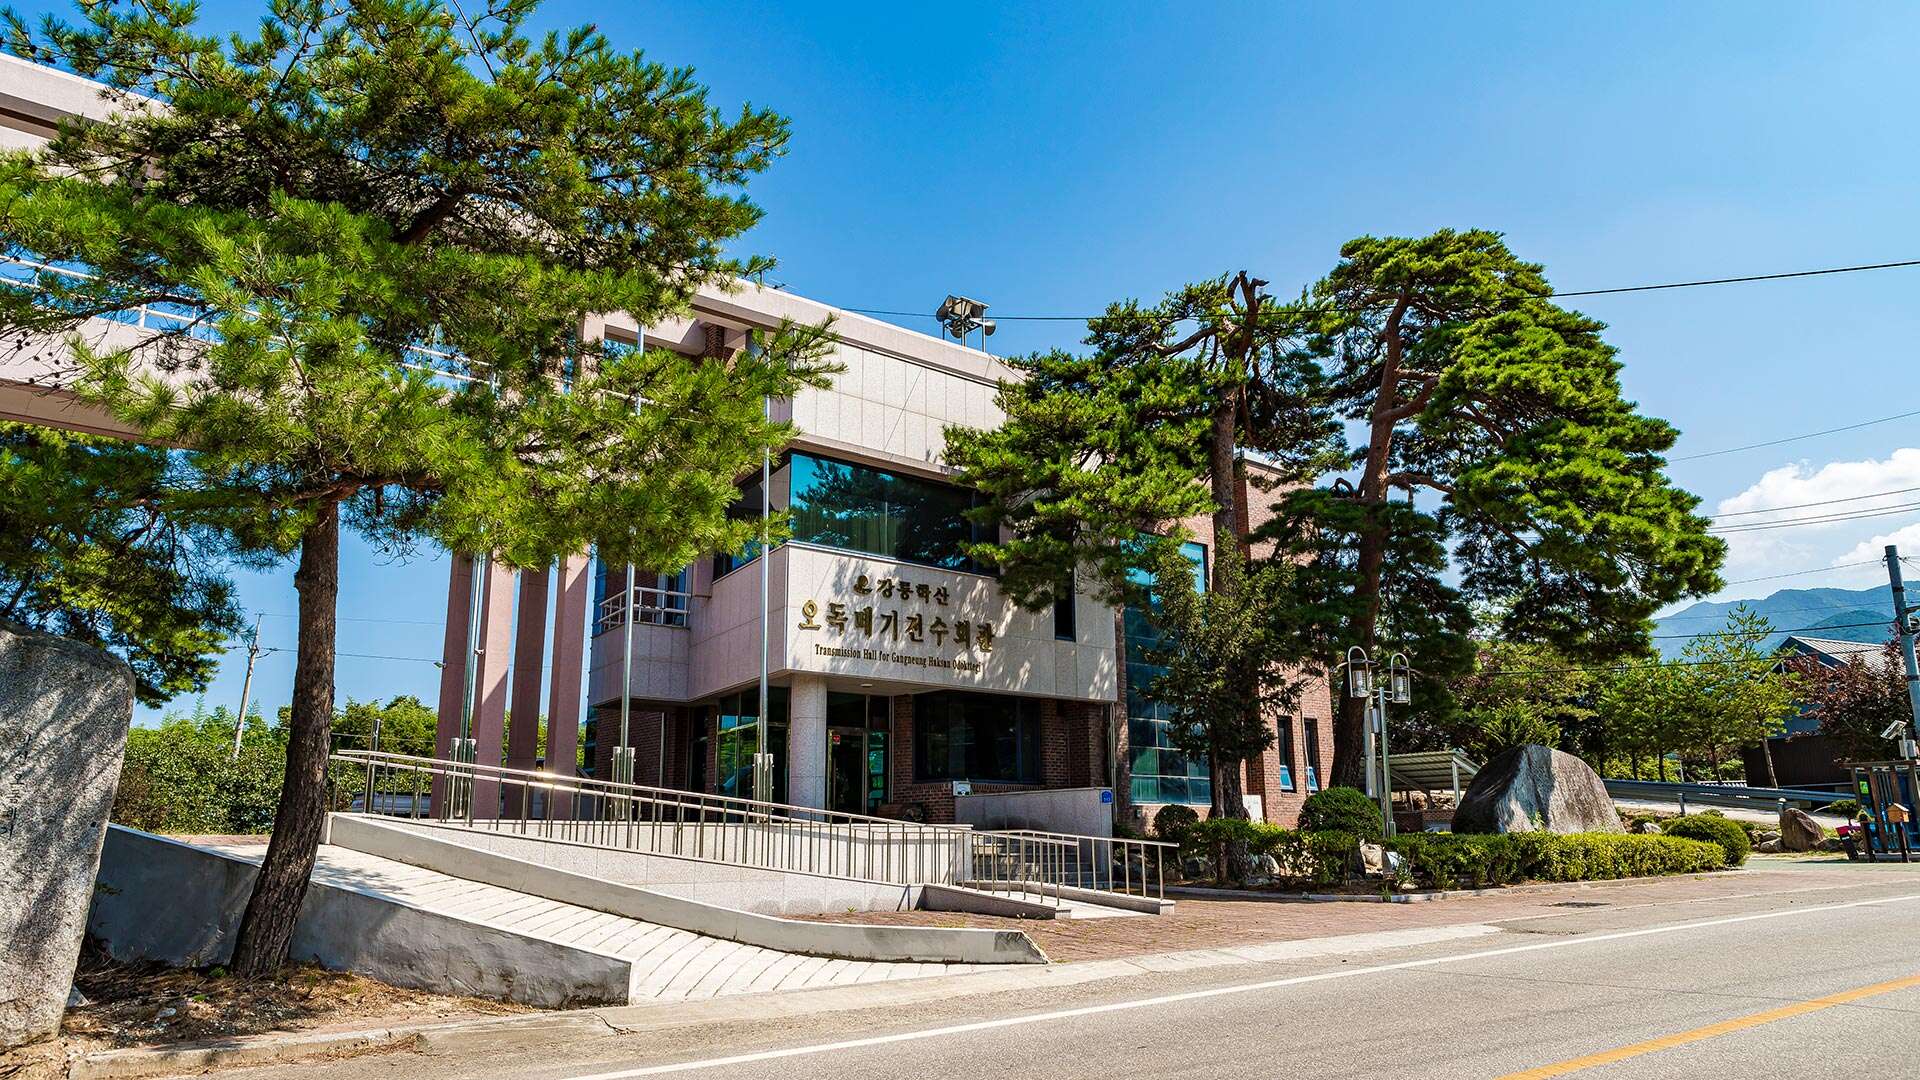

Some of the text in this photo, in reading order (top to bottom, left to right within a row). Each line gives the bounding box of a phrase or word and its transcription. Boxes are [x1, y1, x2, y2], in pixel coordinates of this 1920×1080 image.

[814, 643, 861, 659] Transmission
[863, 648, 877, 661] Hall
[879, 650, 890, 662] for
[891, 652, 927, 669] Gangneung
[928, 655, 951, 669] Haksan
